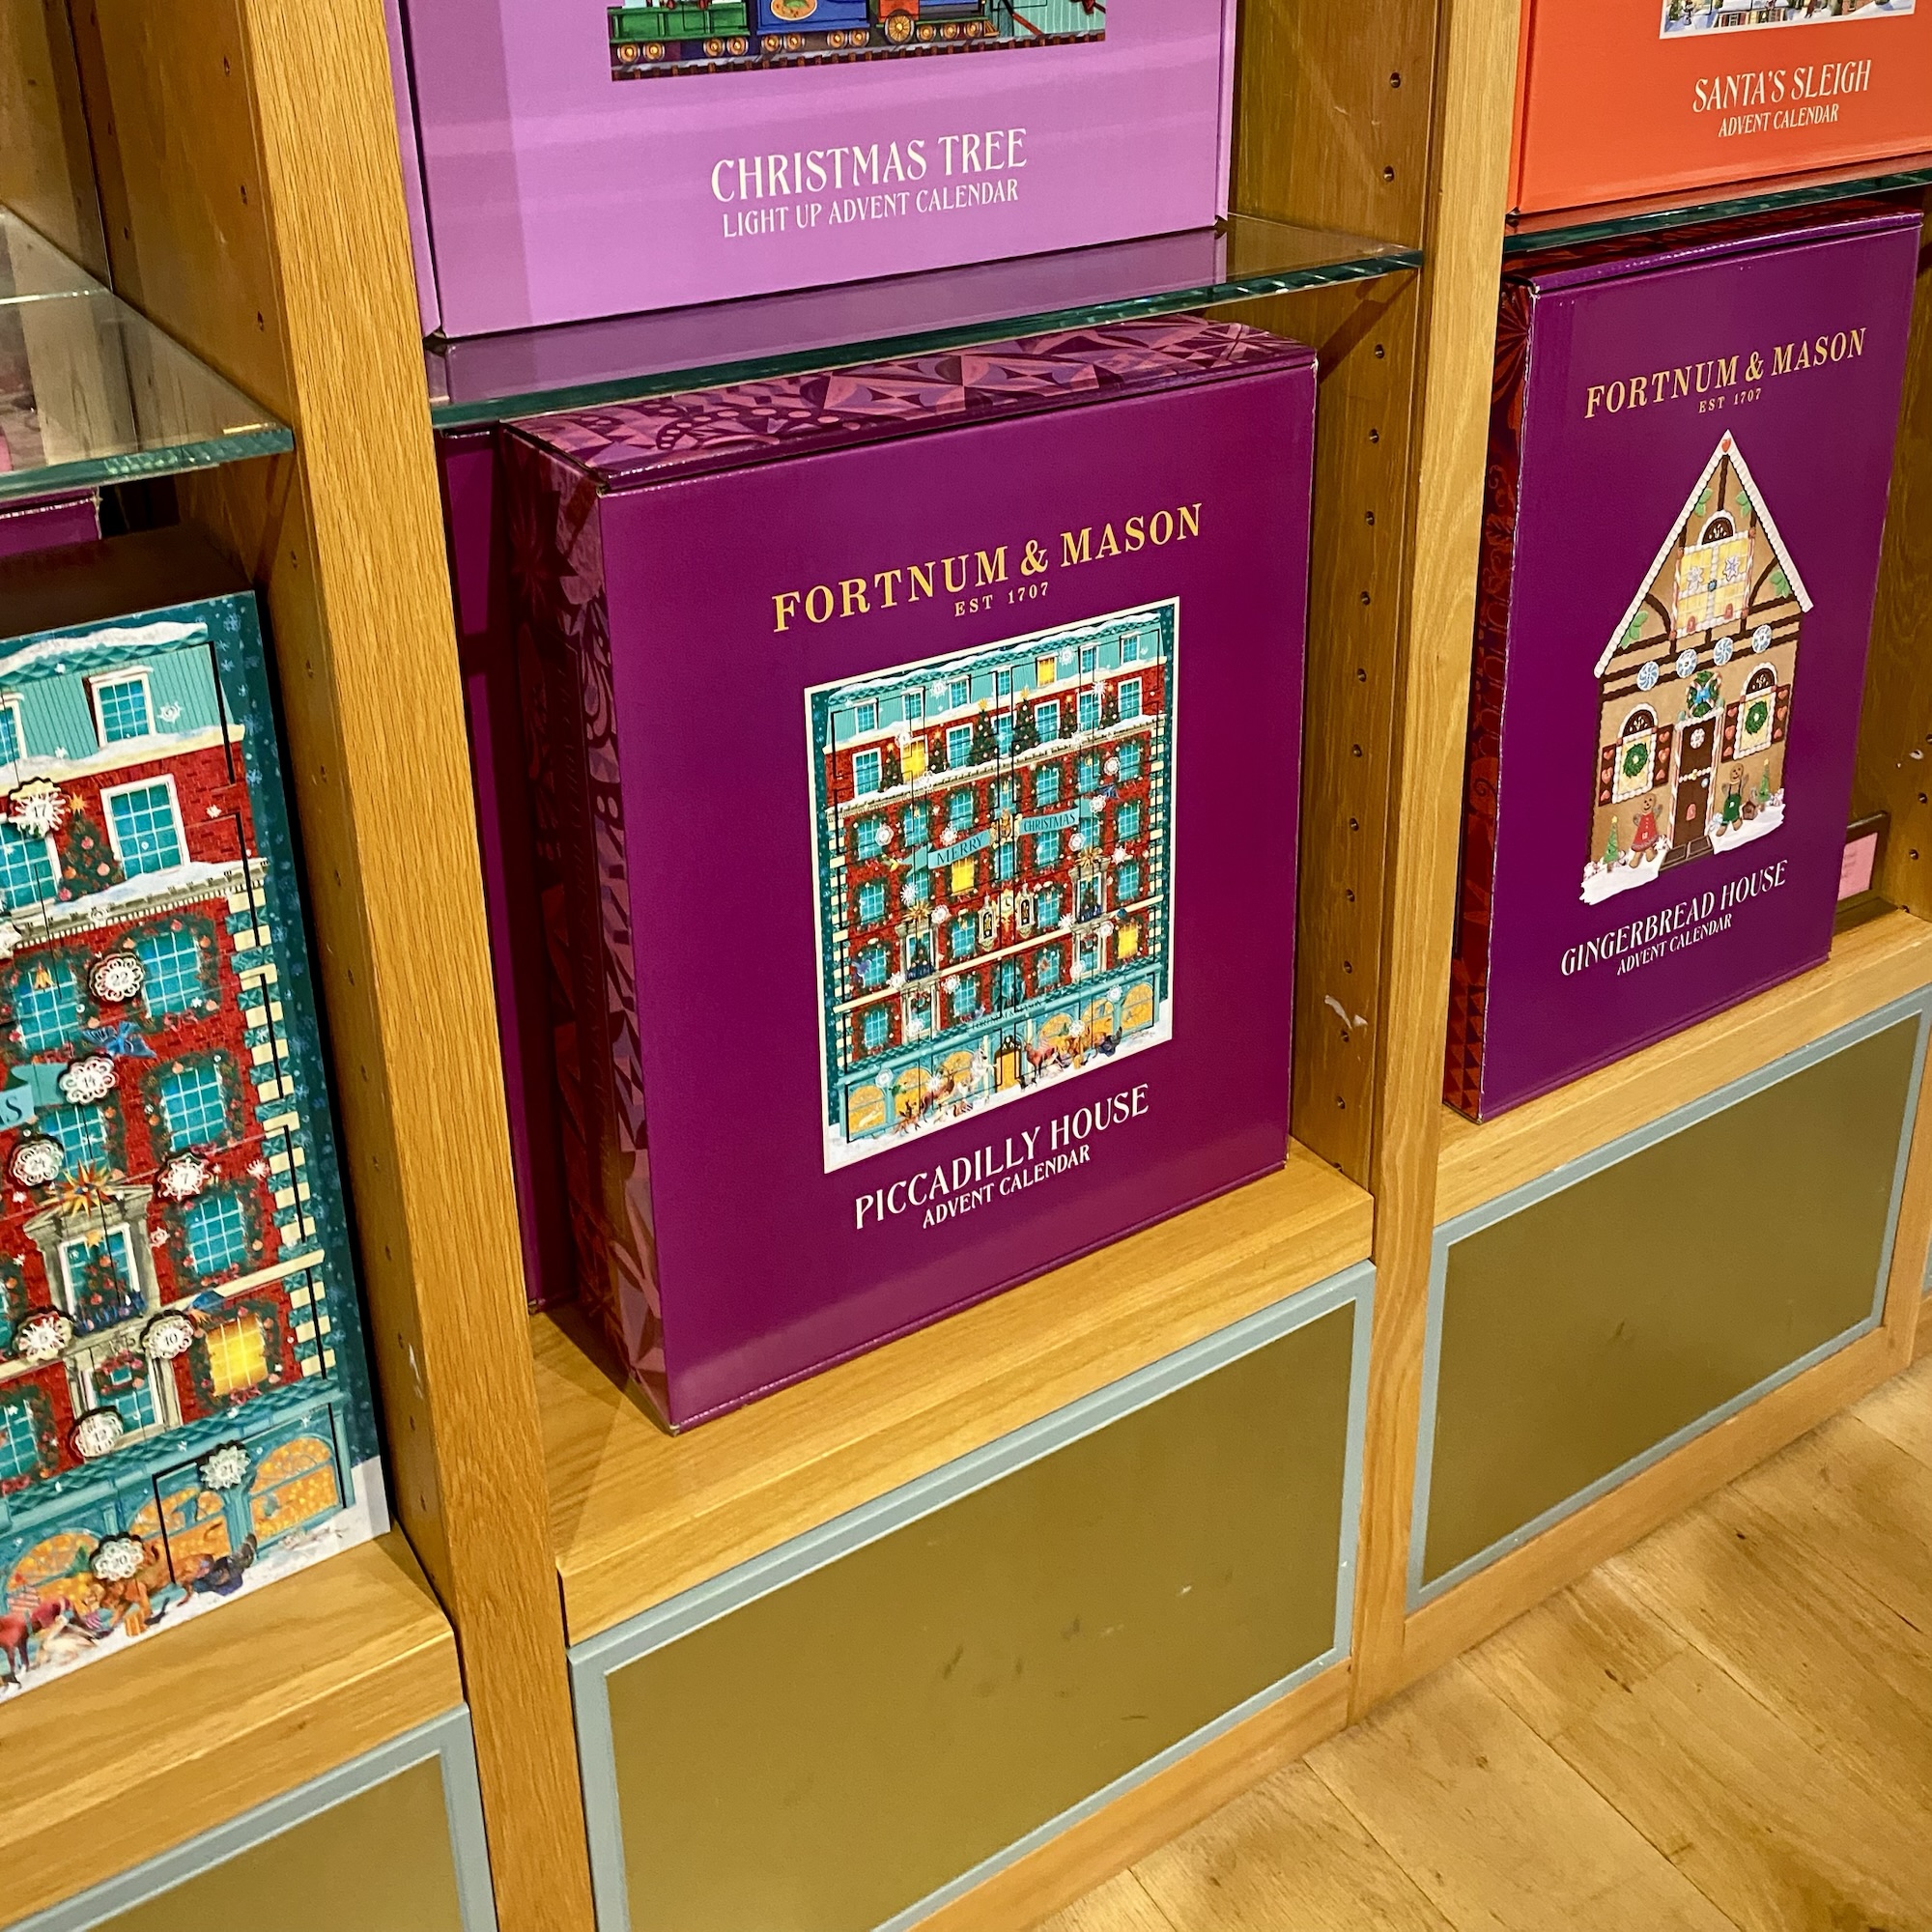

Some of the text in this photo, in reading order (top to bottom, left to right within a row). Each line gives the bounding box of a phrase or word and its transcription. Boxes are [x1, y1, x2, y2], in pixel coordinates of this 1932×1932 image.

[1692, 59, 1872, 113] SANTA'S SLEIGH
[1718, 103, 1839, 138] ADVENT CALENDAR
[711, 128, 1027, 203] CHRISTMAS TREE
[723, 178, 1018, 238] LIGHT UP ADVENT CALENDAR
[1584, 327, 1866, 419] FORTNUM & MASON
[1698, 387, 1762, 413] EST 1707
[771, 502, 1203, 633] FORTNUM & MASON
[954, 582, 1049, 617] EST 1707
[935, 811, 1076, 866] MERRY CHRISTMAS
[1561, 859, 1788, 976] GINGERBREAD HOUSE
[1616, 912, 1732, 976] ADVENT CALENDAR
[110, 970, 129, 987] 22
[855, 1083, 1150, 1230] PICCADILLY HOUSE
[923, 1144, 1091, 1230] ADVENT CALENDAR
